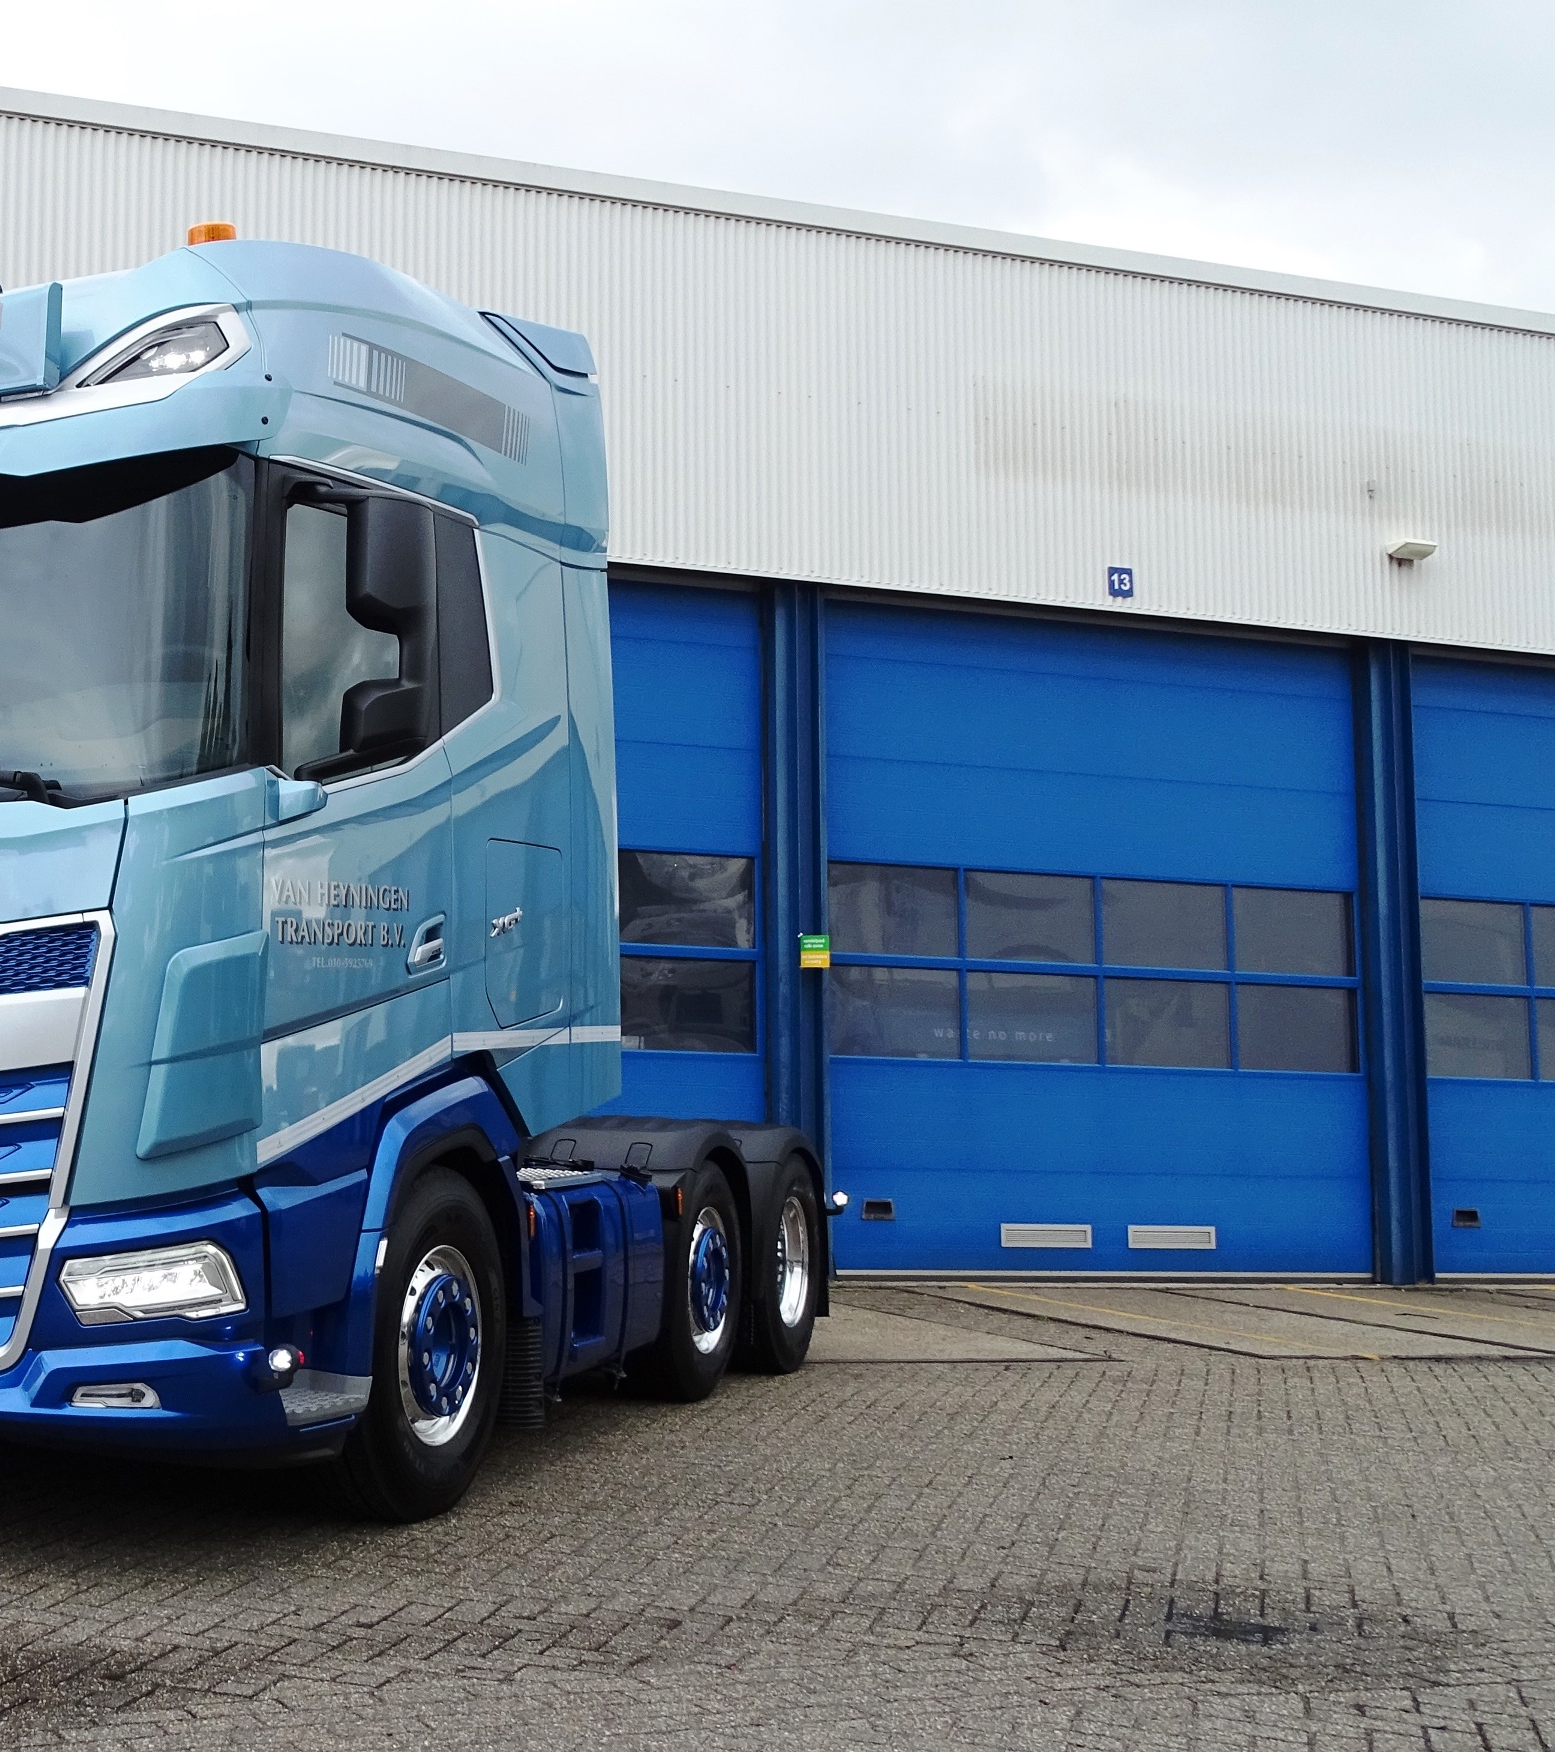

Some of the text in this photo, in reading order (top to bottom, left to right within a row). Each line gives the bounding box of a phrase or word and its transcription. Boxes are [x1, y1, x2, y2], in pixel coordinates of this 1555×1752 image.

[1110, 573, 1131, 591] 13
[270, 877, 410, 911] VAN HEYNINGEN
[275, 916, 378, 947] TRANSPORT
